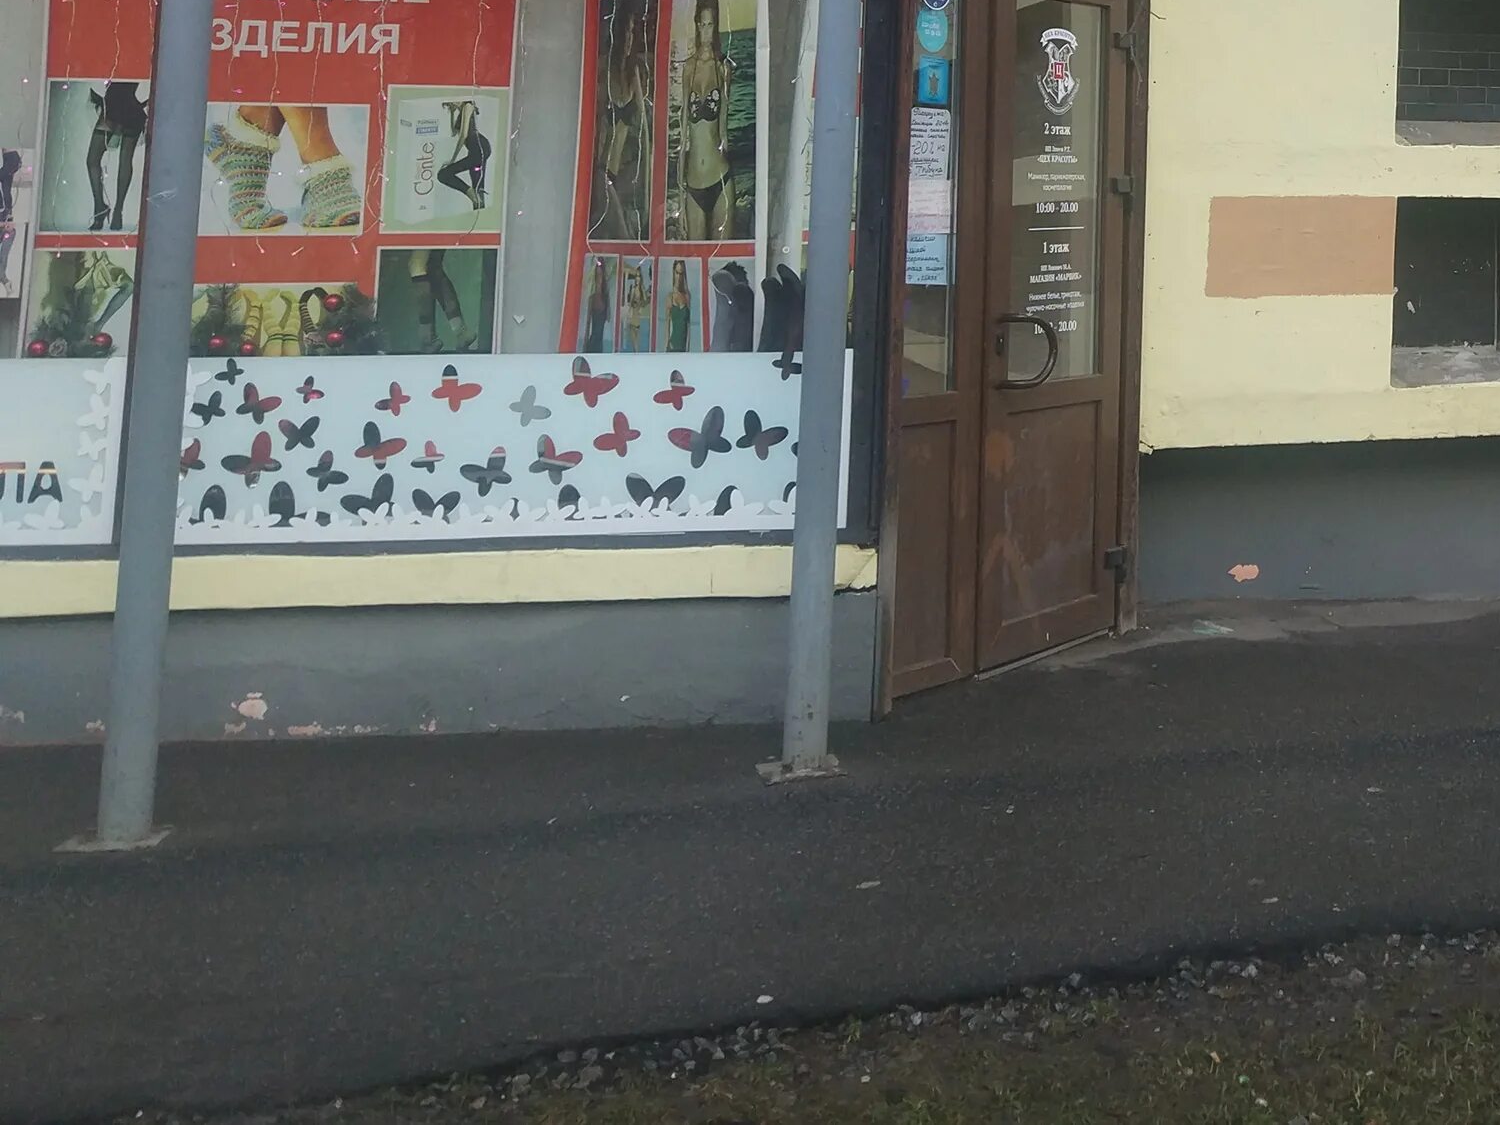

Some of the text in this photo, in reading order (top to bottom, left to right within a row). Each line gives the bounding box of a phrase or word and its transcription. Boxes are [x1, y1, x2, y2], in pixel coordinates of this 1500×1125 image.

[211, 18, 400, 58] ЗДЕЛИЯ
[1044, 123, 1071, 135] 2 этаж
[413, 142, 435, 196] Conte
[1043, 241, 1070, 254] 1 этаж
